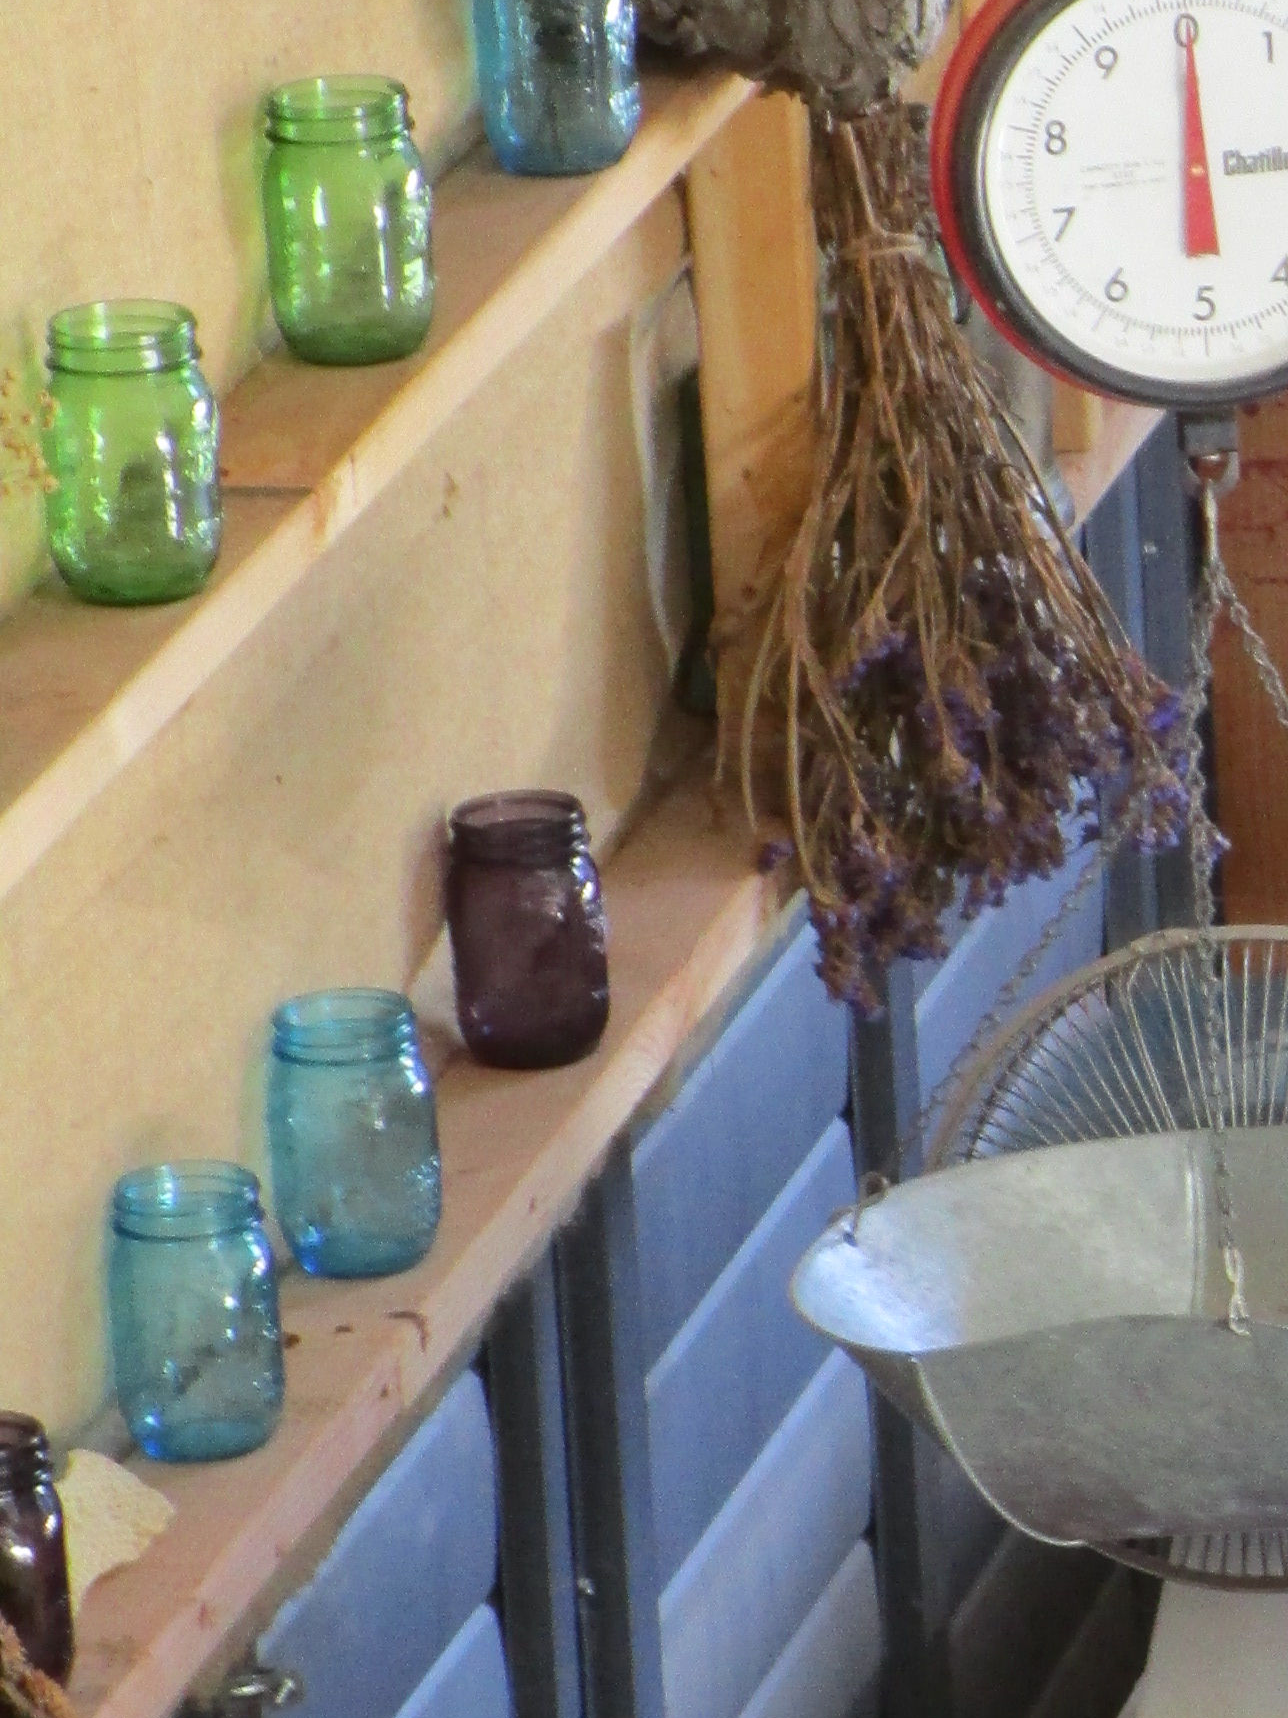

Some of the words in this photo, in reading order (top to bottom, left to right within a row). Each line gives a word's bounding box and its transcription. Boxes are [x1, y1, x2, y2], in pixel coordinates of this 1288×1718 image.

[1174, 14, 1199, 47] 0
[1264, 31, 1276, 64] 1
[1095, 45, 1119, 79] 9
[1045, 120, 1068, 155] 8
[1052, 207, 1077, 242] 7
[1105, 269, 1128, 302] 6
[1194, 286, 1216, 321] 5
